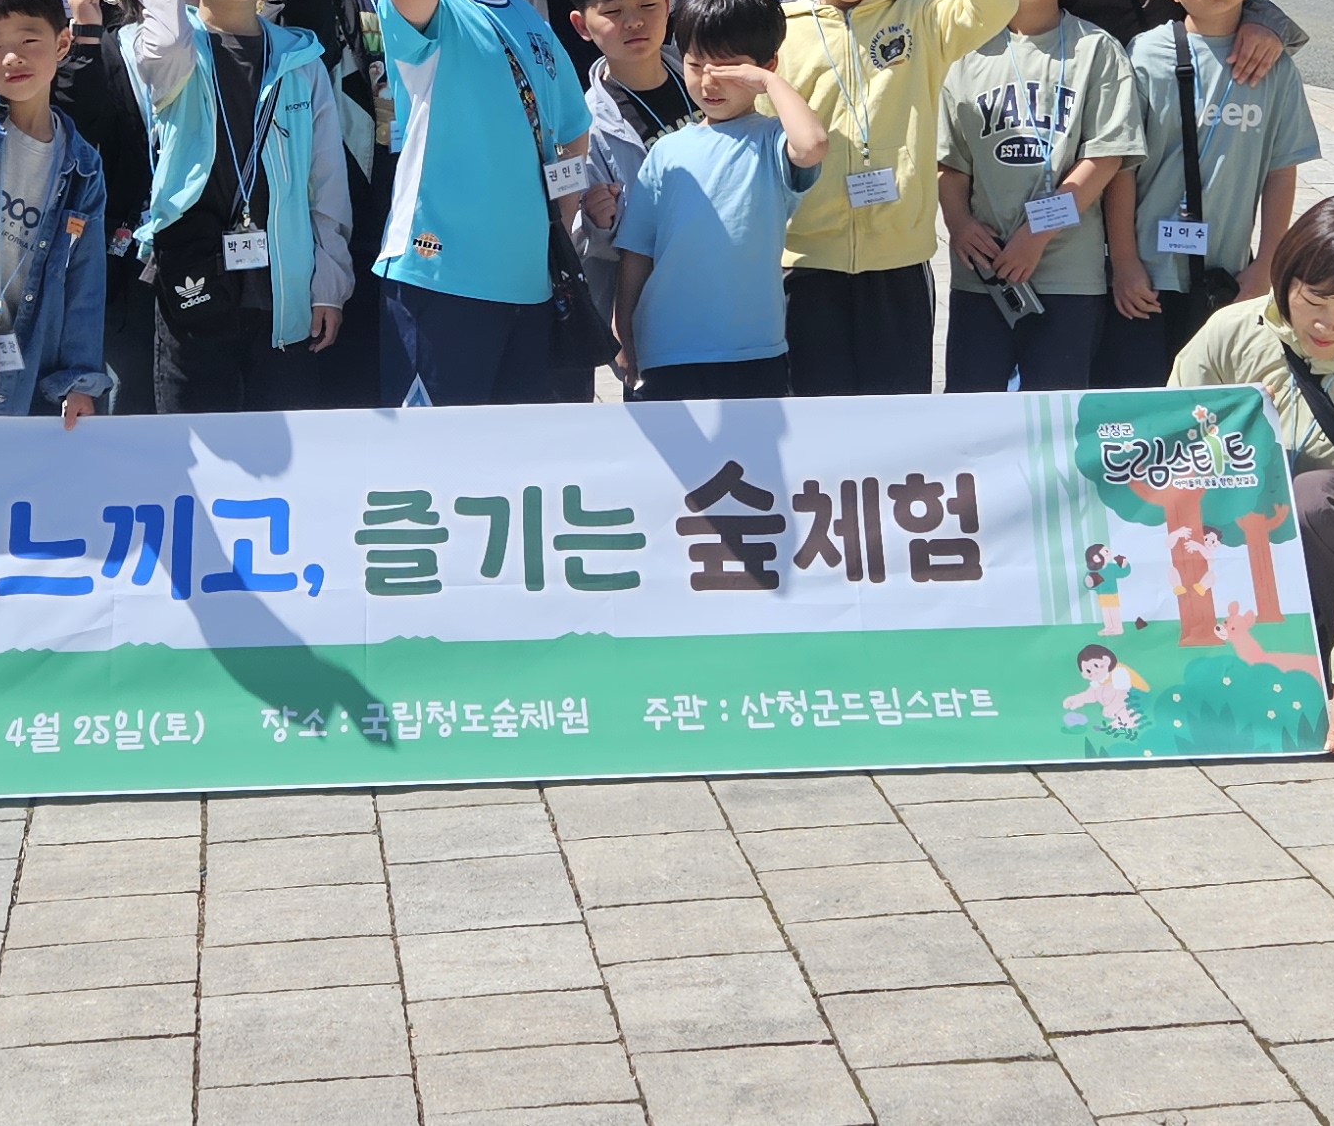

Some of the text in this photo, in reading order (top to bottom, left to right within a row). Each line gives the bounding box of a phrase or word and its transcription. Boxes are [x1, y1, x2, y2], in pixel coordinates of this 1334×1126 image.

[975, 81, 1077, 139] YALE
[1202, 102, 1263, 132] eep
[1162, 226, 1205, 239] 김이수
[180, 293, 211, 309] adidas
[1098, 423, 1133, 437] 산청군
[1102, 433, 1254, 488] 드림스타트
[354, 484, 646, 596] 즐기는
[675, 460, 983, 591] 숲체험
[4, 711, 61, 754] 4월
[73, 709, 205, 751] 25일(토)
[260, 703, 328, 744] 장소
[360, 697, 590, 742] 국립청도숲체원
[643, 694, 708, 733] 주관
[740, 686, 1000, 729] 산청군드림스타트
